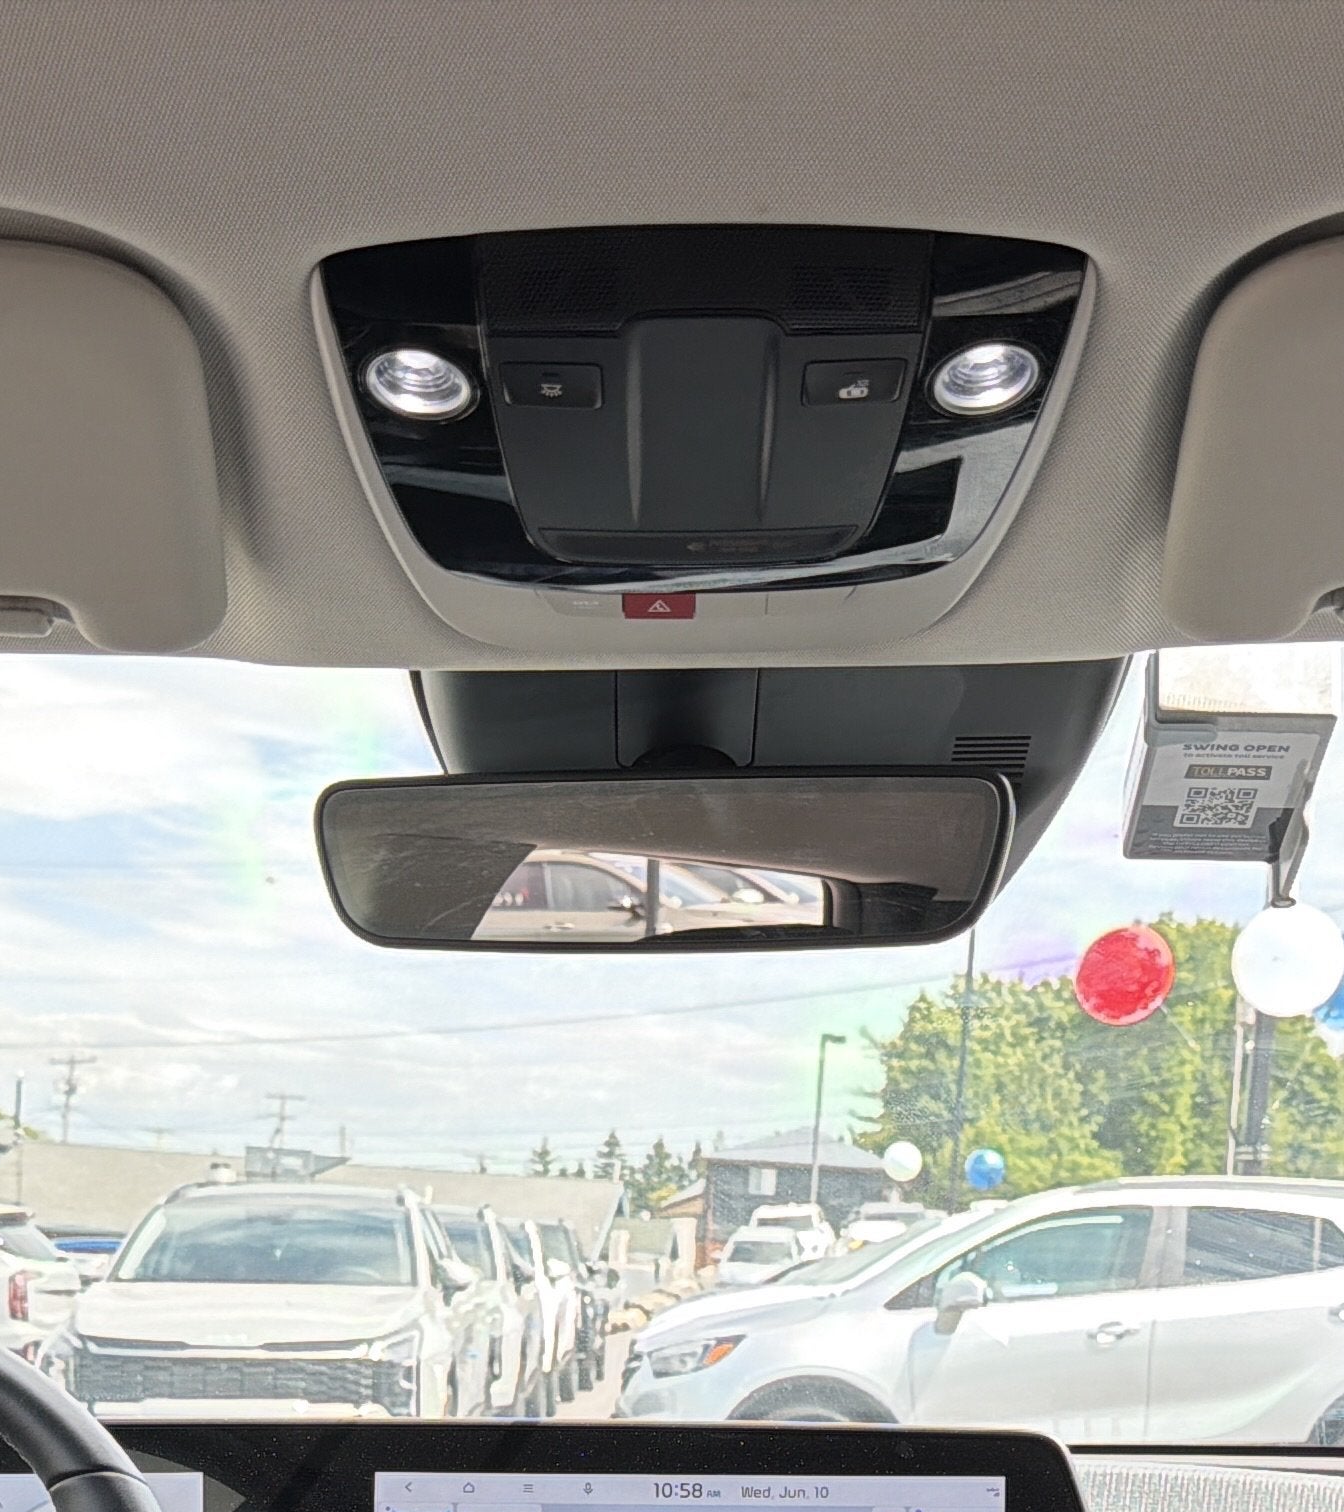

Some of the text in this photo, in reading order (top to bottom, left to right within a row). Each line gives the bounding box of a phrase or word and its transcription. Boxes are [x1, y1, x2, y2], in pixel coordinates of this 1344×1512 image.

[1182, 744, 1291, 753] SWING OPEN
[653, 1482, 703, 1499] 10:58
[707, 1490, 721, 1498] AM
[812, 1486, 830, 1500] 10
